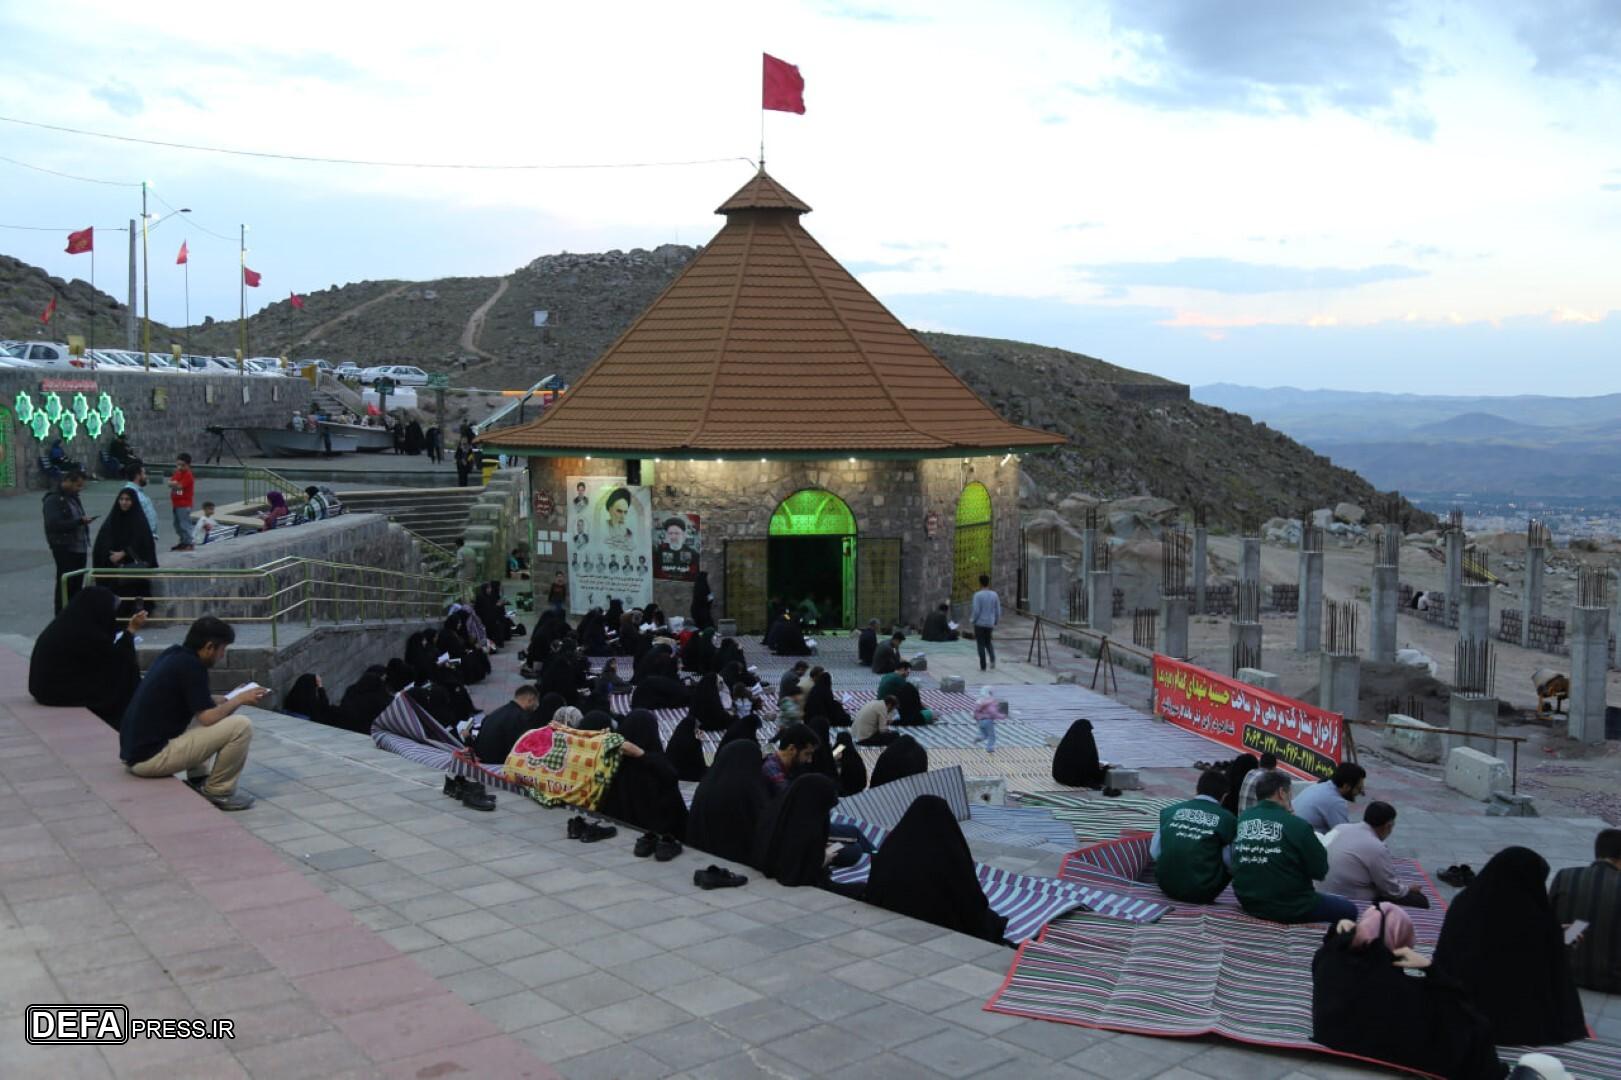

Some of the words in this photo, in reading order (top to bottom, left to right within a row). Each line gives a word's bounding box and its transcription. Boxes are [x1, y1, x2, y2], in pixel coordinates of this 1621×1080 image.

[1186, 672, 1207, 702] شهدای
[1208, 682, 1230, 708] حسینیه
[1231, 689, 1251, 712] ساخت
[1252, 698, 1260, 722] در
[1262, 705, 1285, 731] مردمی
[1285, 707, 1312, 739] مشارکت
[1312, 716, 1338, 754] فراخوان
